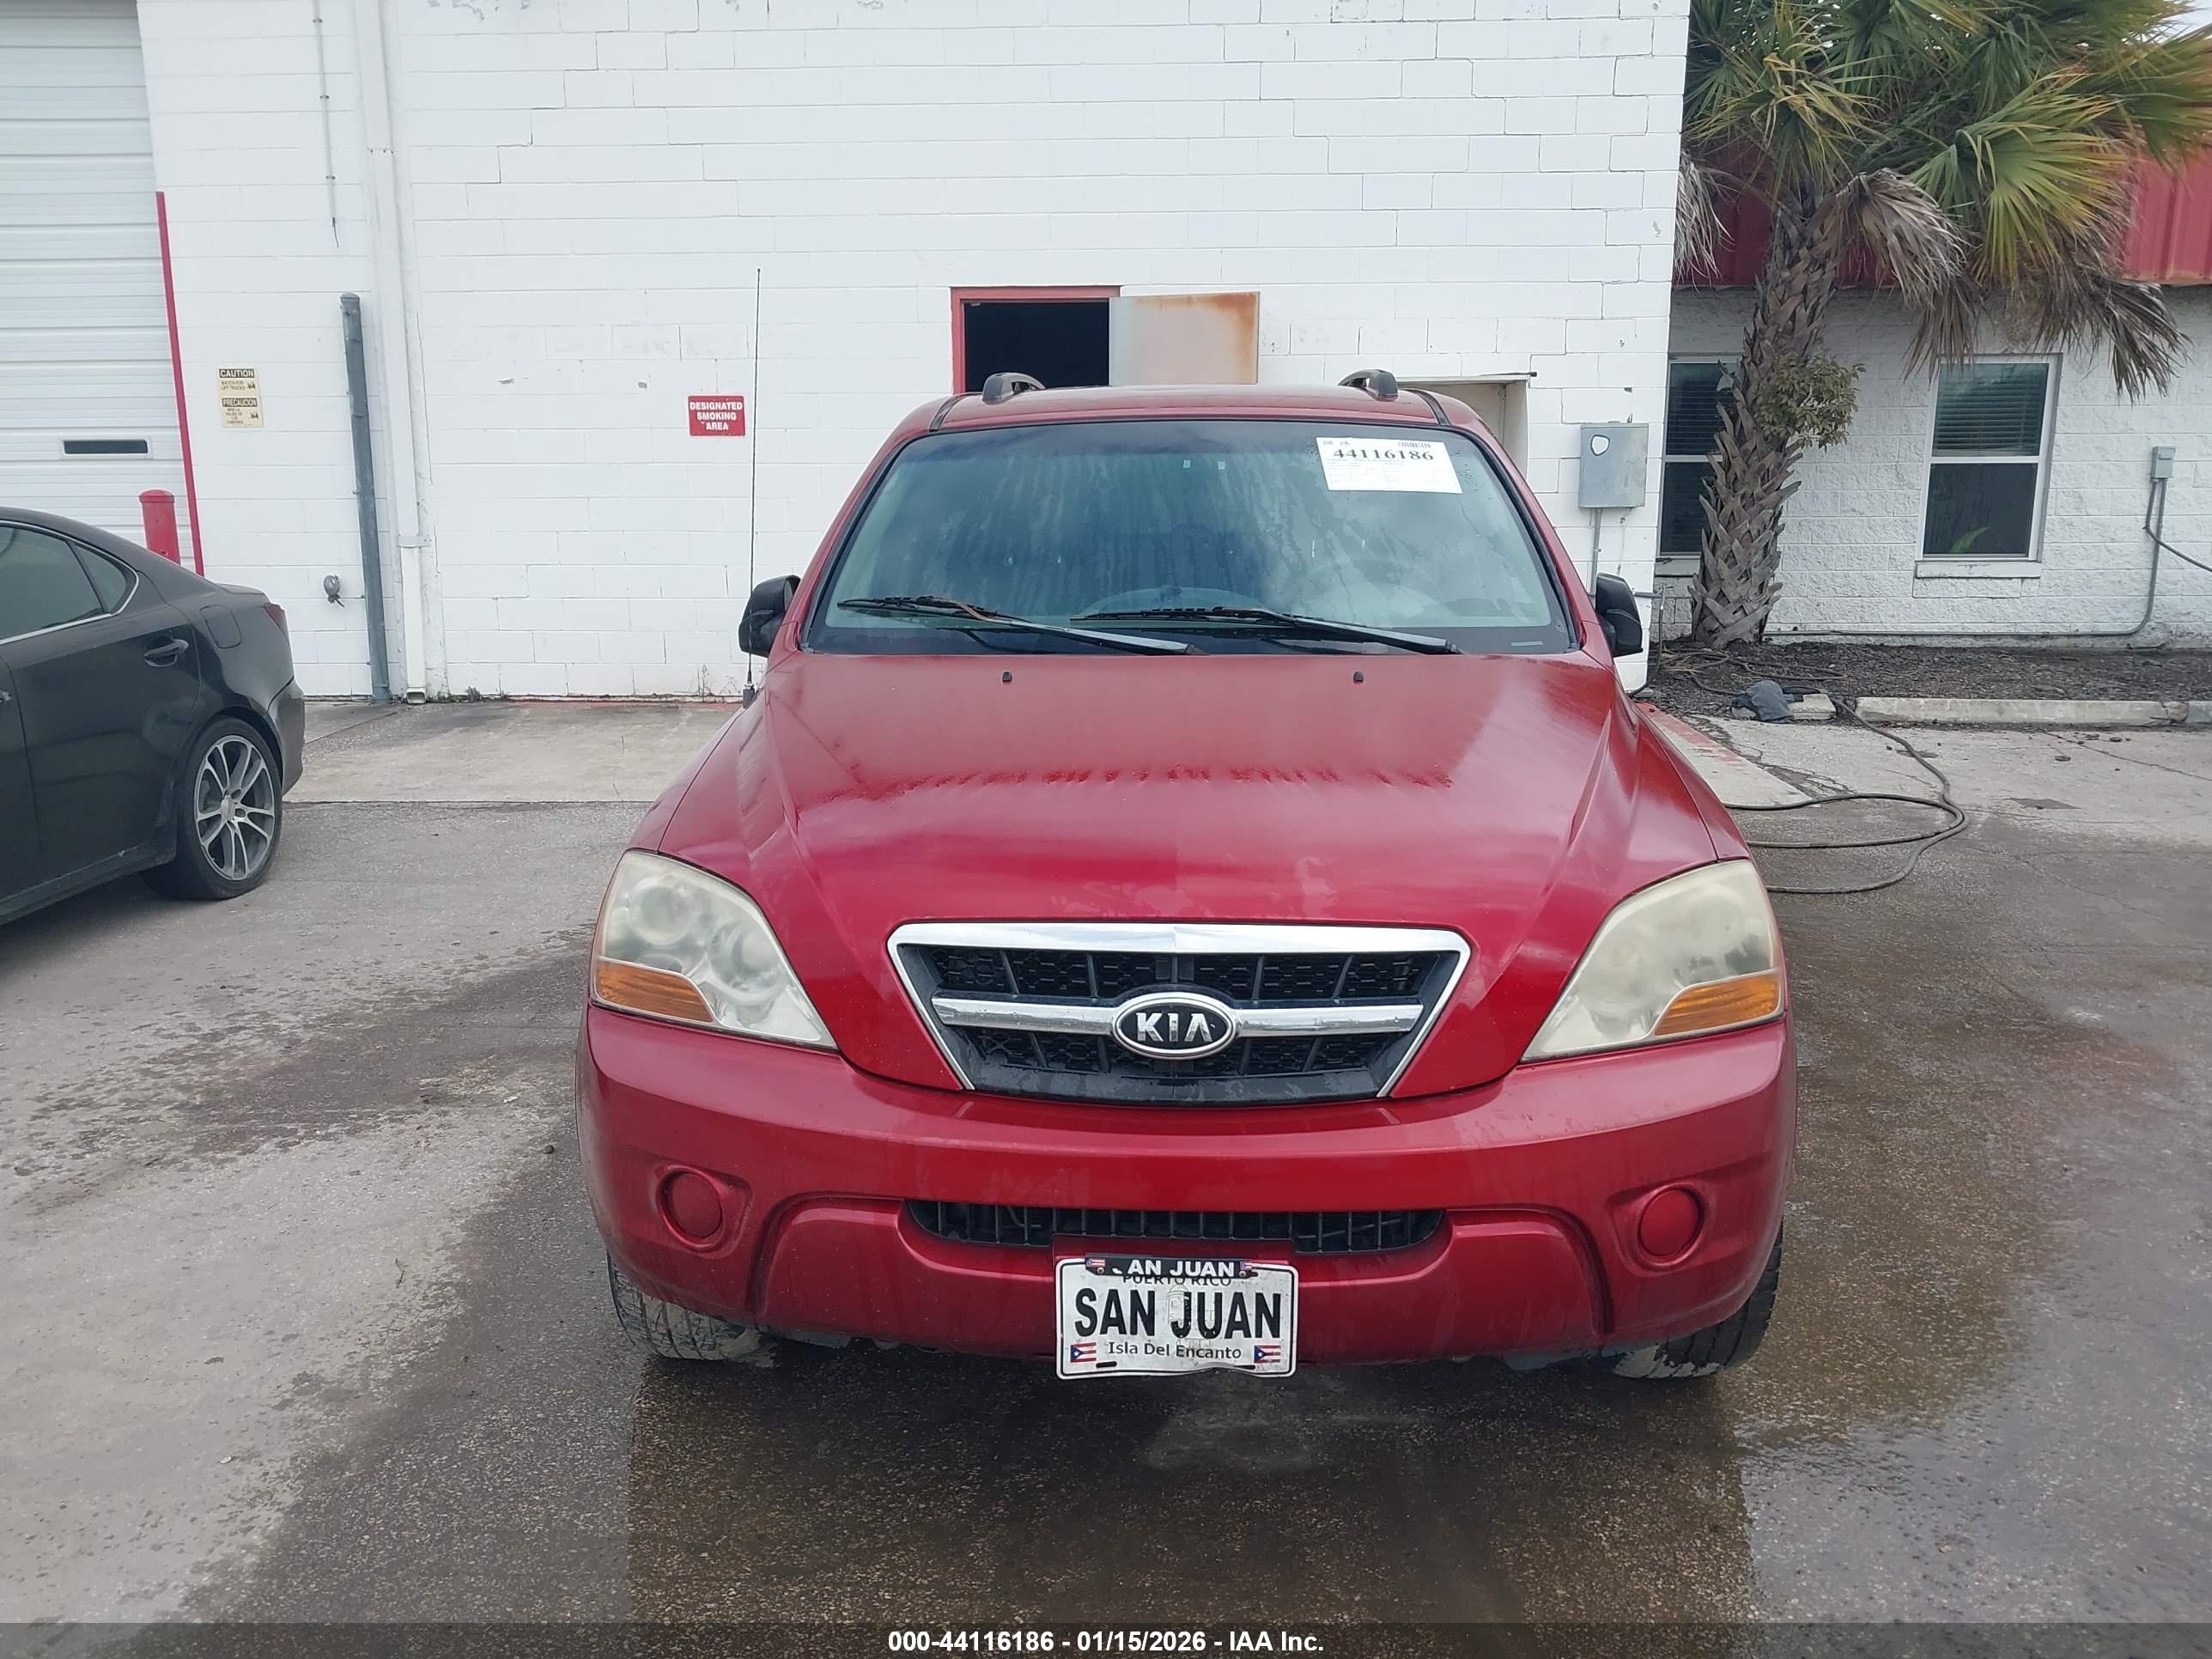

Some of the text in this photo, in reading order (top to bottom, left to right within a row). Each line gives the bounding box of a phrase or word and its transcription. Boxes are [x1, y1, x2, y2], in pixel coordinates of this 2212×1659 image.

[220, 369, 254, 378] CAUTION
[690, 402, 743, 410] DESIGNATED
[696, 411, 737, 421] SMOKING
[706, 422, 729, 430] AREA
[1333, 448, 1434, 461] 44116186
[1135, 1012, 1213, 1042] KIA
[1112, 1259, 1235, 1278] AN JUAN
[1074, 1287, 1282, 1340] SAN JUAN
[1108, 1341, 1242, 1359] Isla Del Encanto
